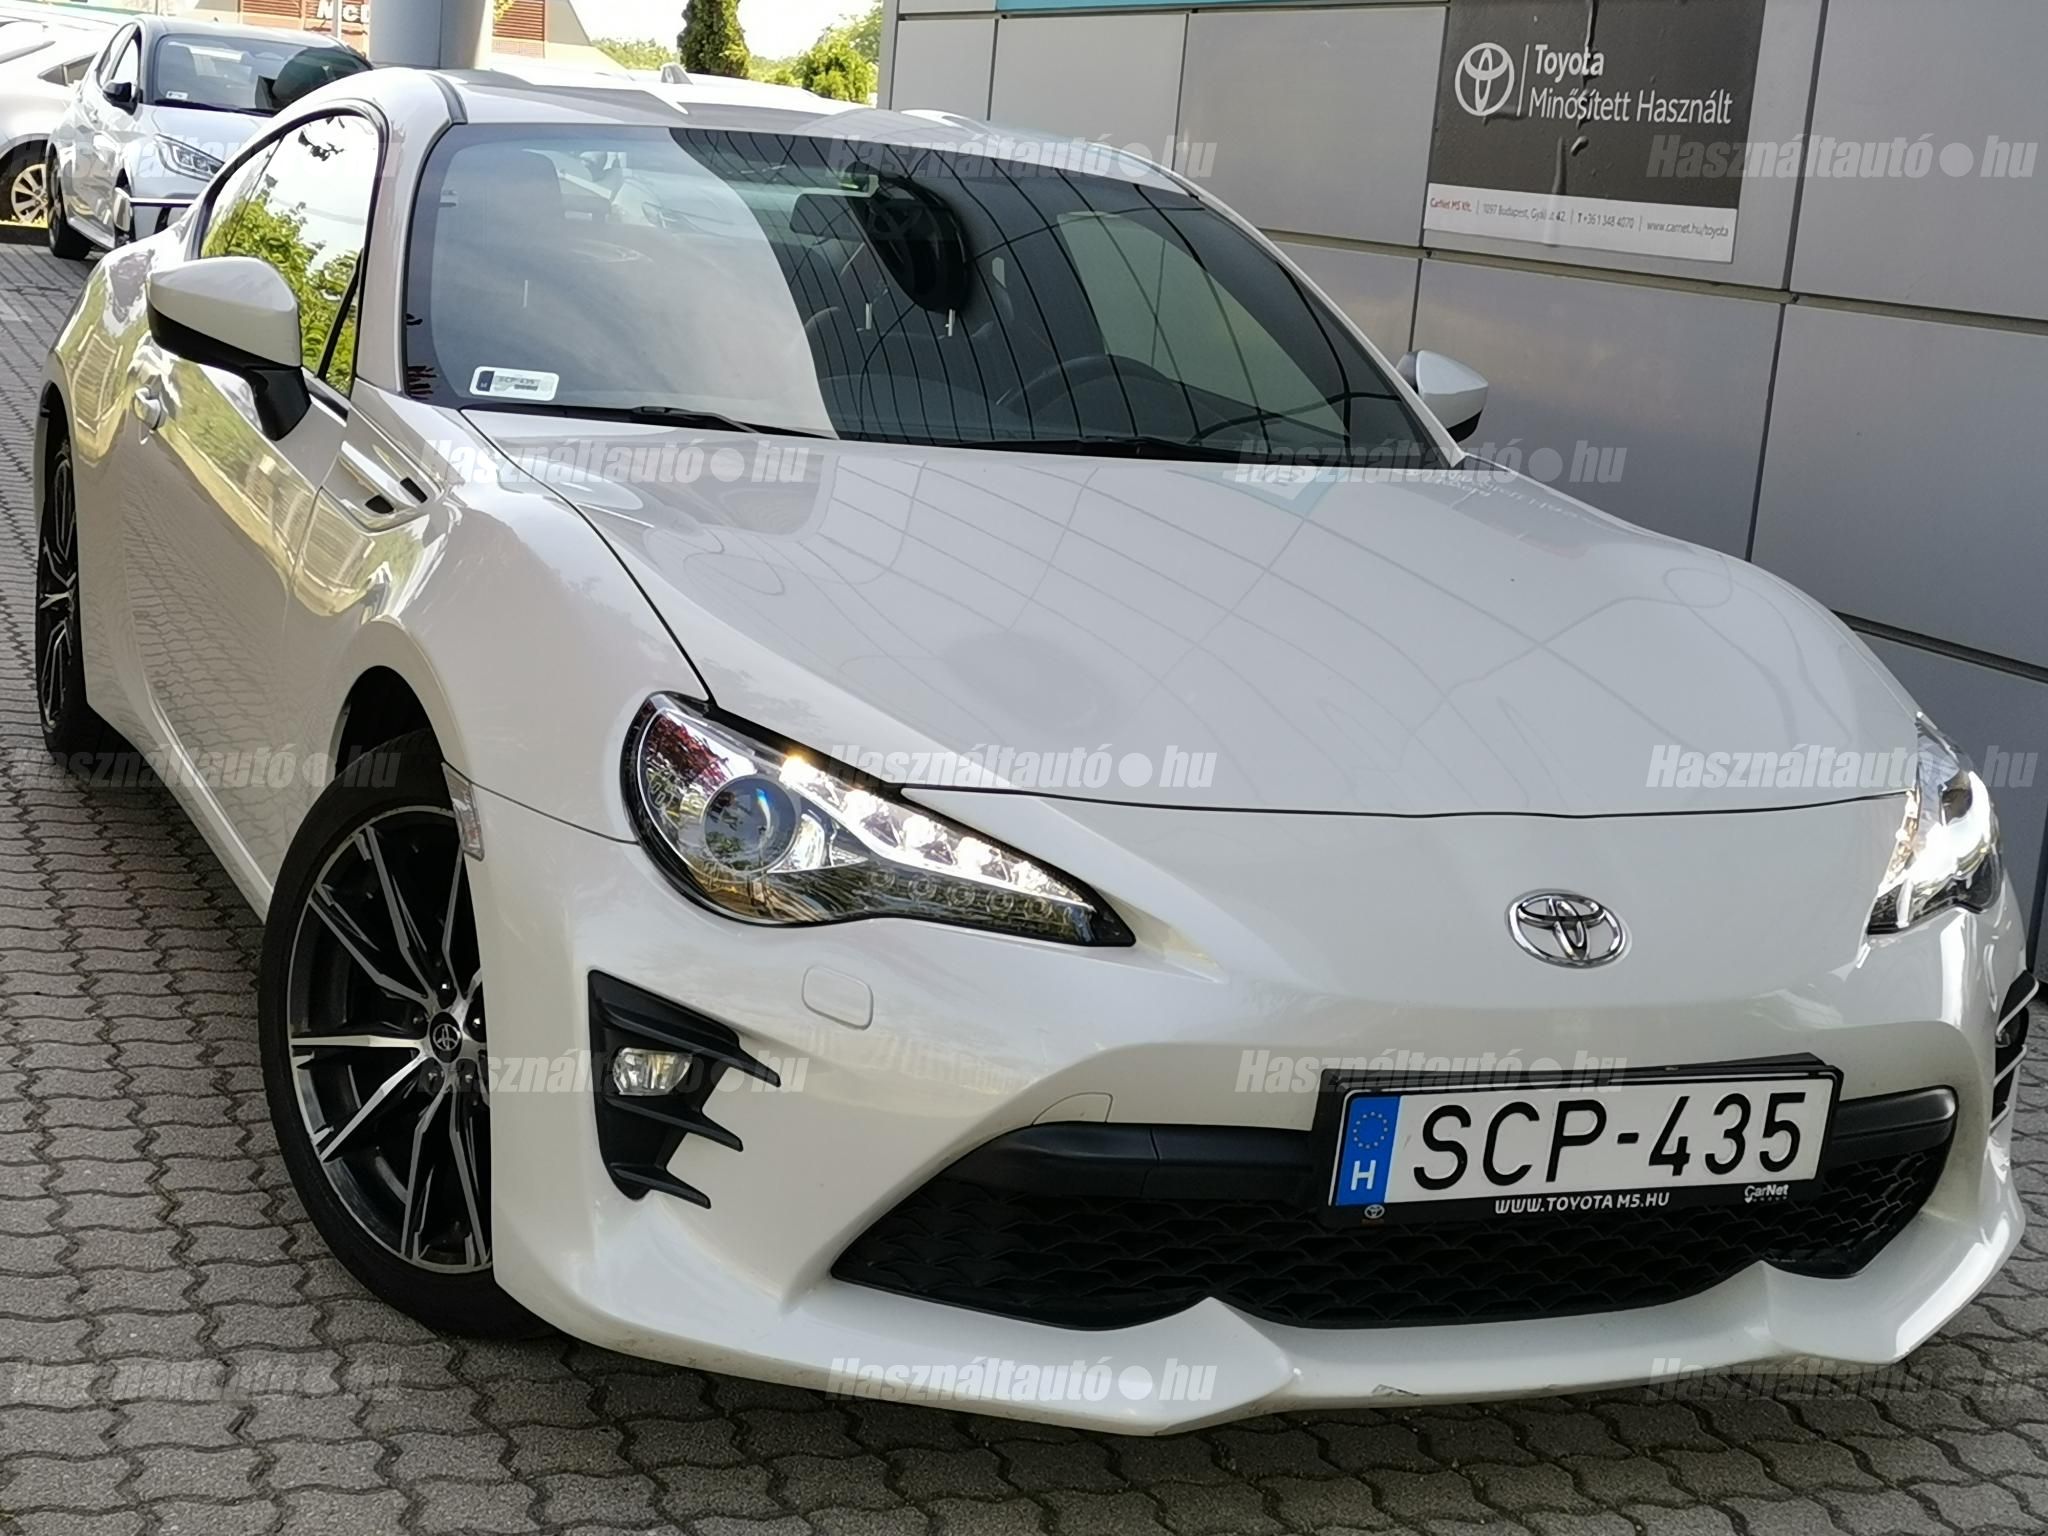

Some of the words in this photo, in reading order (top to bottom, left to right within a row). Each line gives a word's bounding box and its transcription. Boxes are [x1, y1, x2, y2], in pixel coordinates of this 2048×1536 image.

[1535, 44, 1604, 83] Toyota
[1528, 86, 1631, 122] Minősített
[1636, 88, 1733, 124] Használt
[1413, 1091, 1807, 1191] SCP-435
[1350, 1160, 1377, 1191] H
